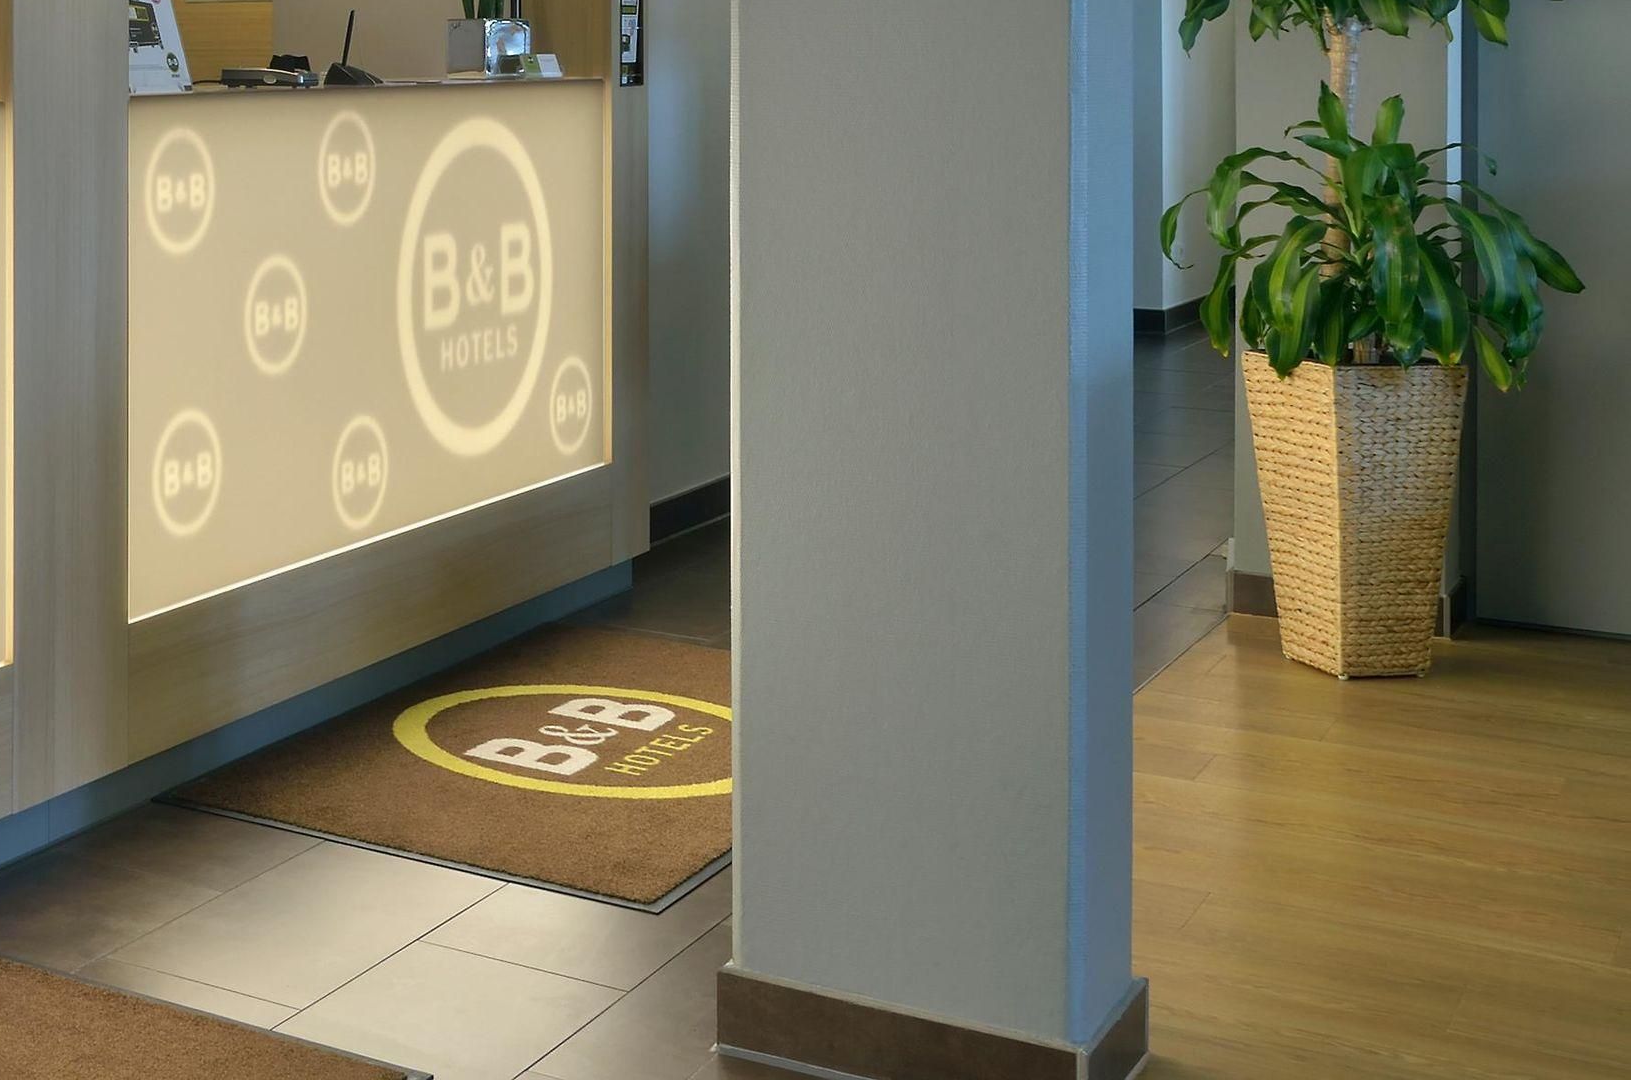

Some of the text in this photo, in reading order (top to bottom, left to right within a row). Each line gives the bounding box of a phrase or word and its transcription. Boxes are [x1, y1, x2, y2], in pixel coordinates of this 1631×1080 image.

[155, 172, 205, 213] B&B
[327, 151, 369, 188] B&B
[423, 221, 535, 332] B&B
[254, 296, 299, 338] B&B
[440, 323, 519, 373] HOTELS
[555, 388, 587, 424] B&B
[164, 451, 213, 499] B&B
[340, 452, 382, 496] B&B
[463, 698, 676, 776] B&B
[604, 723, 714, 776] HOTELS
